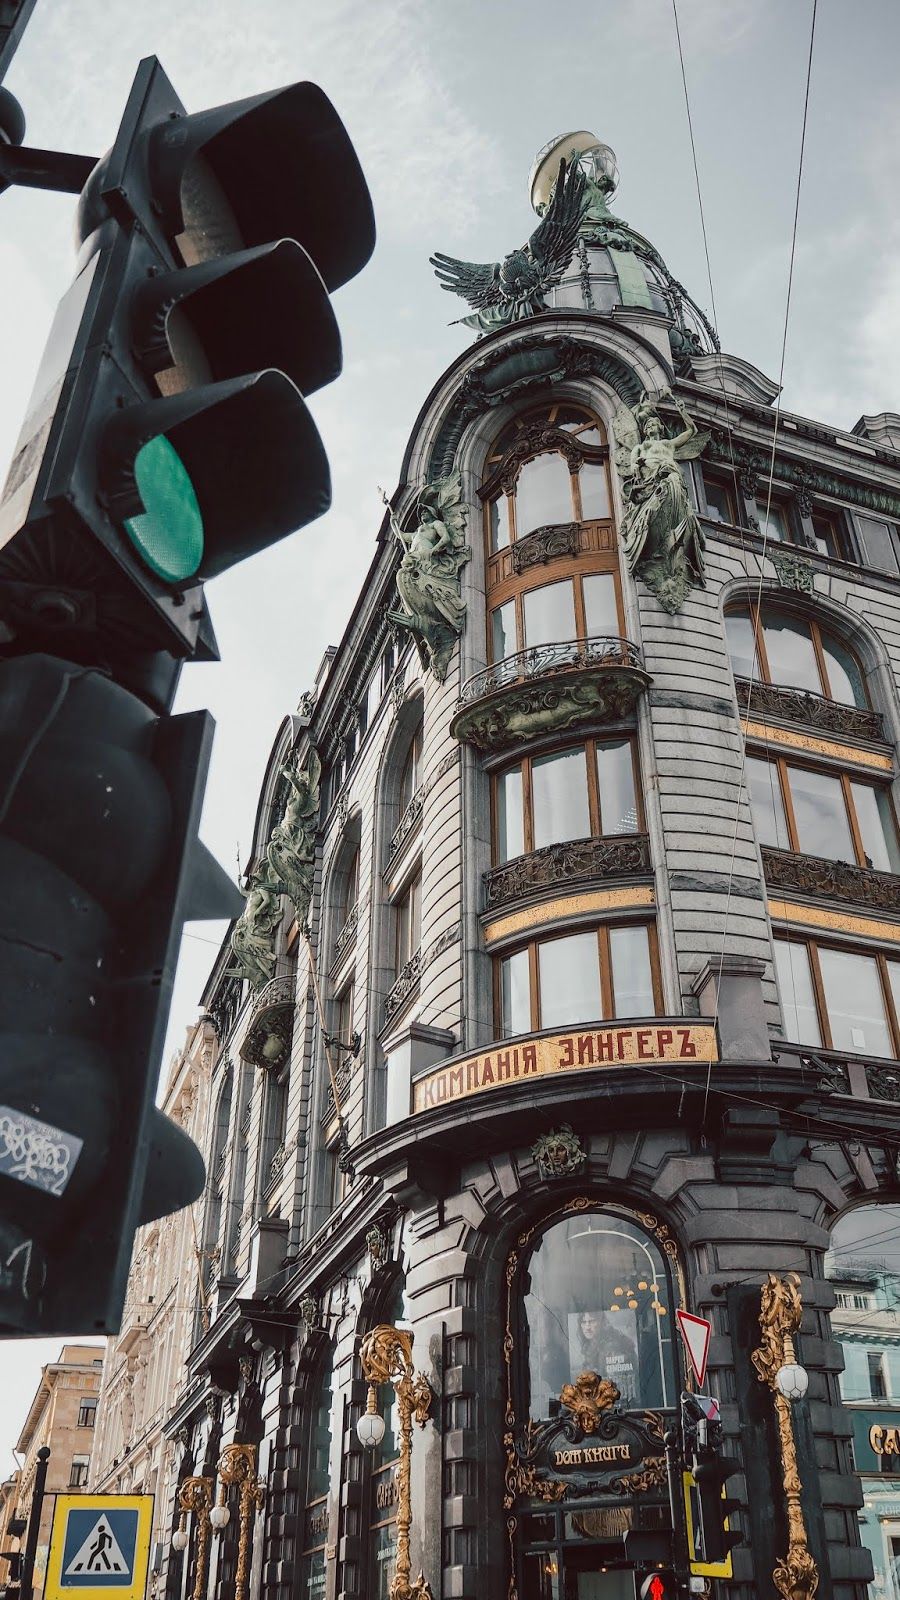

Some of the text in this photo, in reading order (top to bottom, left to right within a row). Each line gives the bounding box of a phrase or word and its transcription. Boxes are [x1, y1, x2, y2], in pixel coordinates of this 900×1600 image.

[423, 1029, 697, 1109] КОМПАНІЯ ЗИНГЕРЪ
[554, 1444, 631, 1466] ДОМ КНИГИ
[868, 1424, 900, 1455] CA
